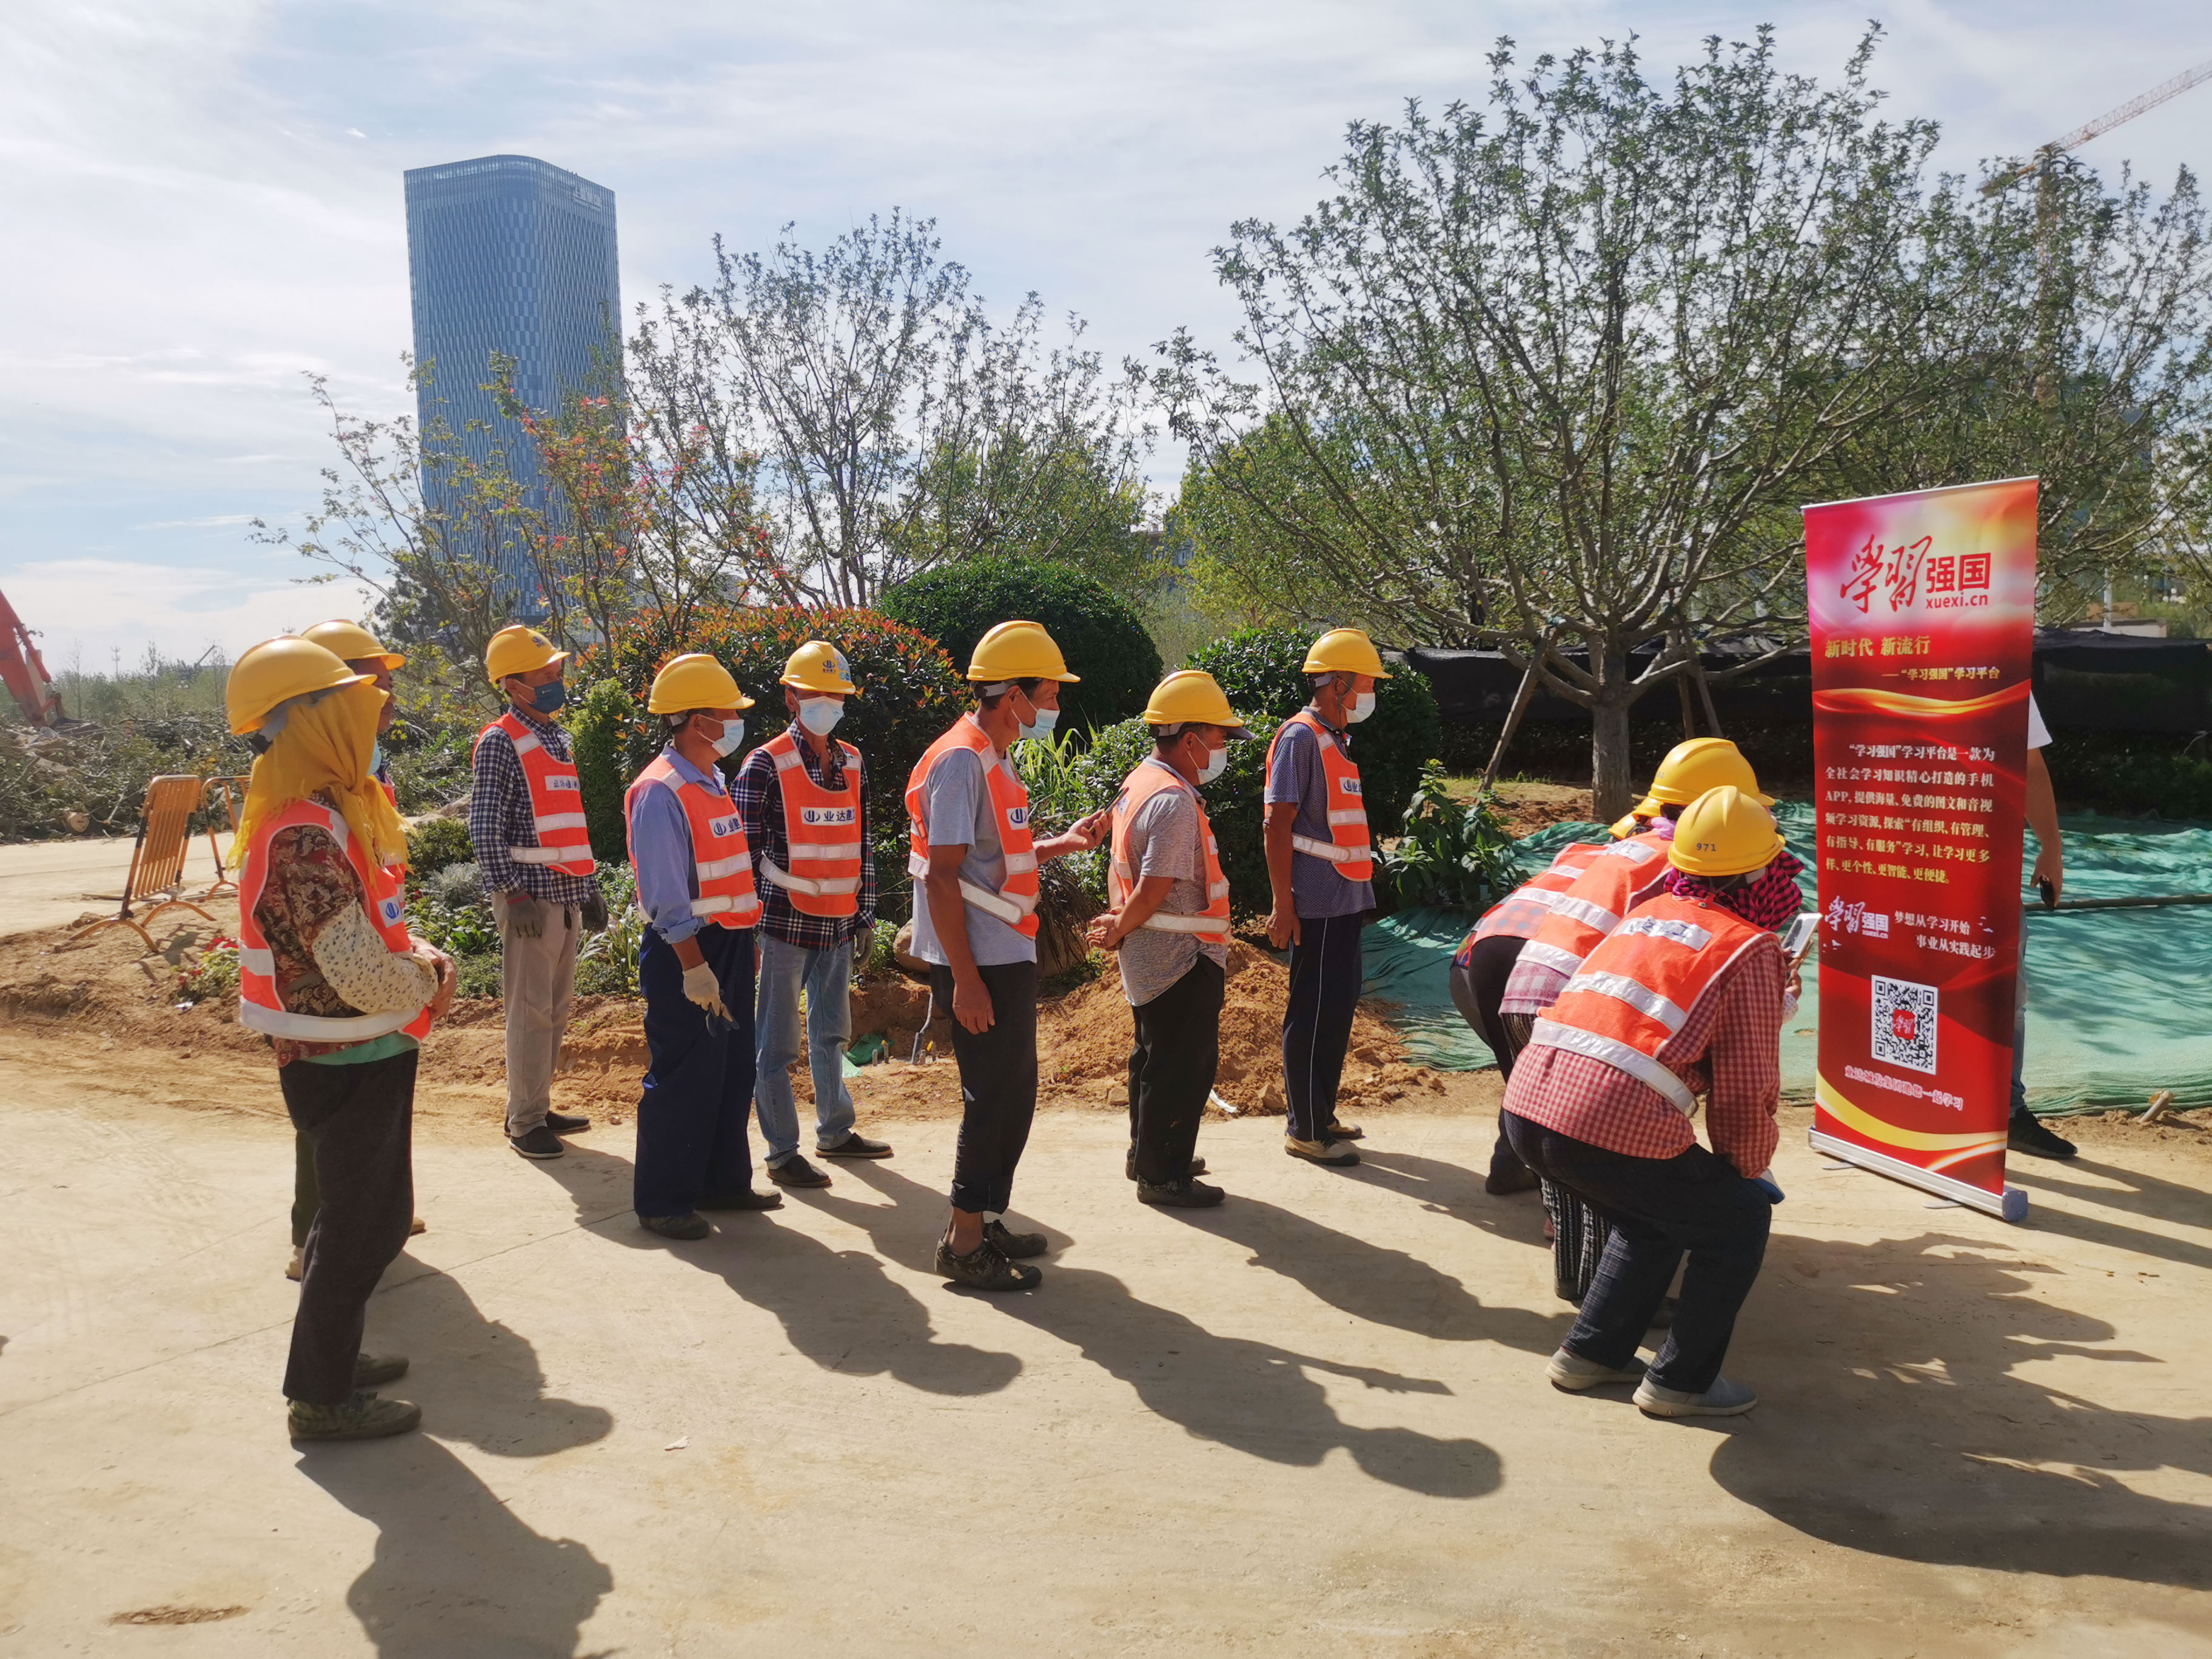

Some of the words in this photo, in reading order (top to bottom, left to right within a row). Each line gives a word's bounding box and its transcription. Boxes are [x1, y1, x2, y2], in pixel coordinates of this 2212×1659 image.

[1925, 592, 1988, 609] xuexi.cn
[1825, 638, 1874, 659] 新时代
[1880, 635, 1931, 656] 新流行
[1825, 766, 1994, 786] 全社会学习知识精心打造的手机
[1697, 842, 1716, 852] 971
[1894, 910, 1970, 935] 梦想从学习开始
[1915, 934, 1996, 959] 事业从实践起步
